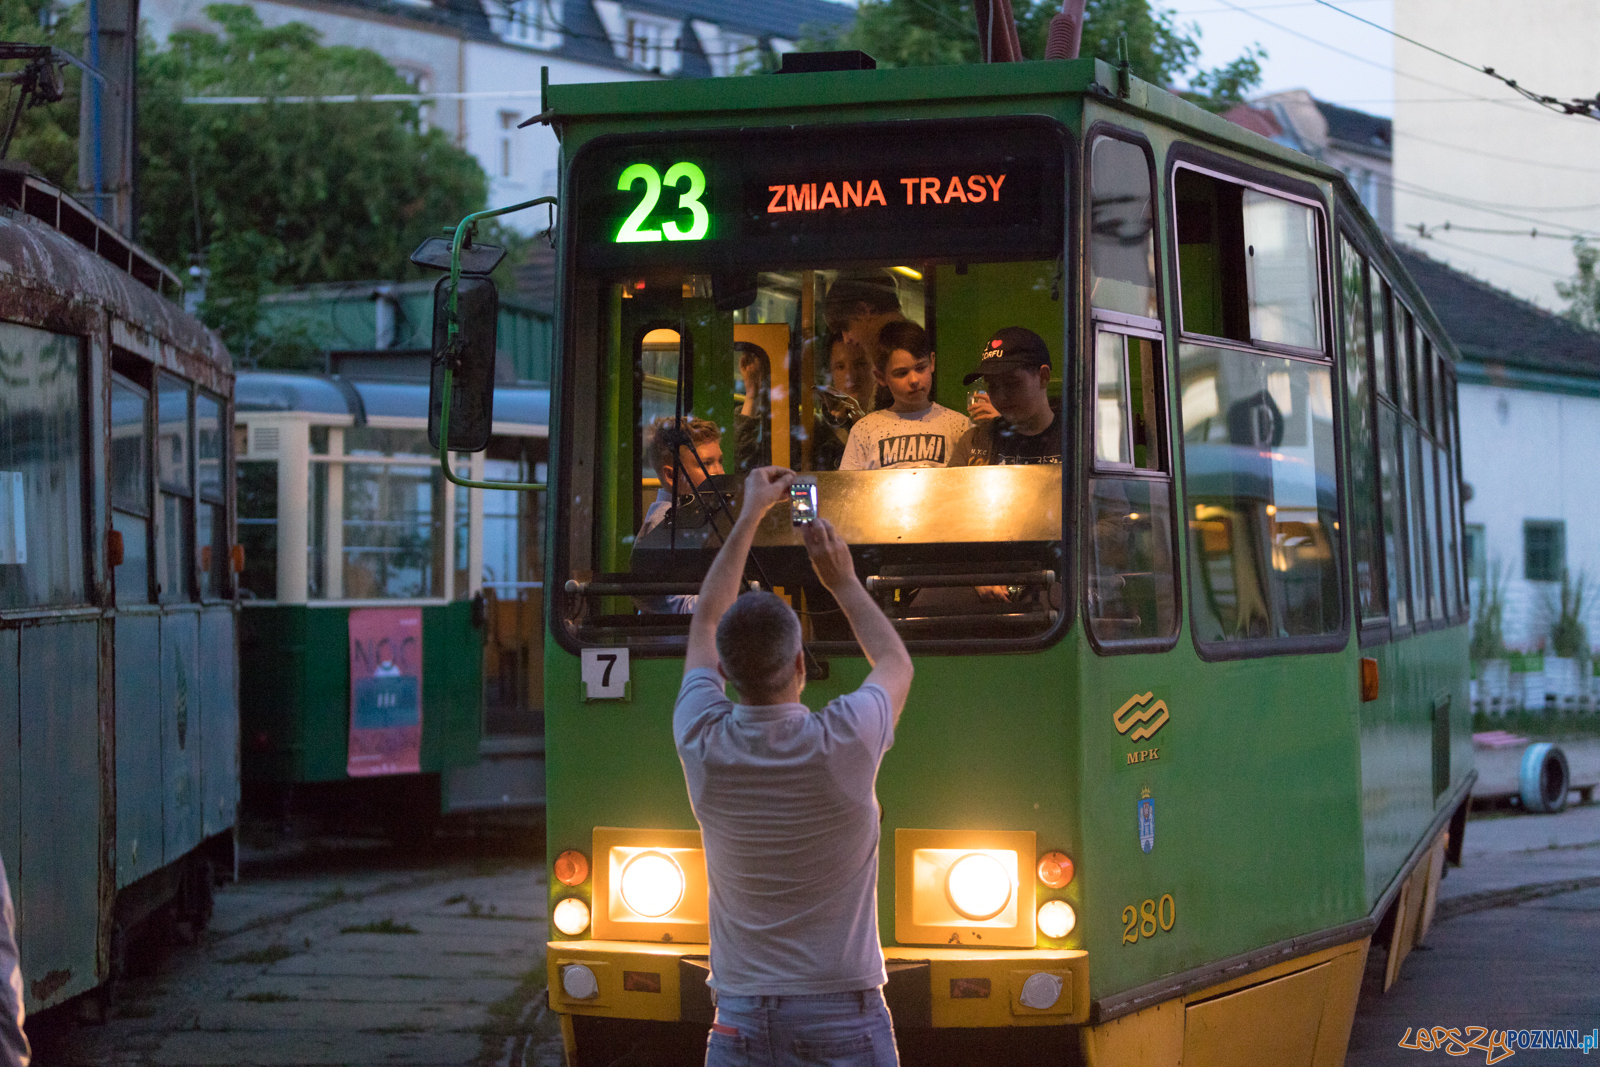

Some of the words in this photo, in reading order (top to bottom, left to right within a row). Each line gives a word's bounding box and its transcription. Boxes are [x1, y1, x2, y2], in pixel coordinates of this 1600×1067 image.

[615, 161, 710, 243] 23
[767, 179, 888, 214] ZMIANA
[900, 173, 1007, 206] TRASY
[883, 434, 943, 466] MIAMI
[596, 654, 618, 688] 7
[1126, 747, 1161, 766] MPK
[1121, 893, 1177, 946] 280
